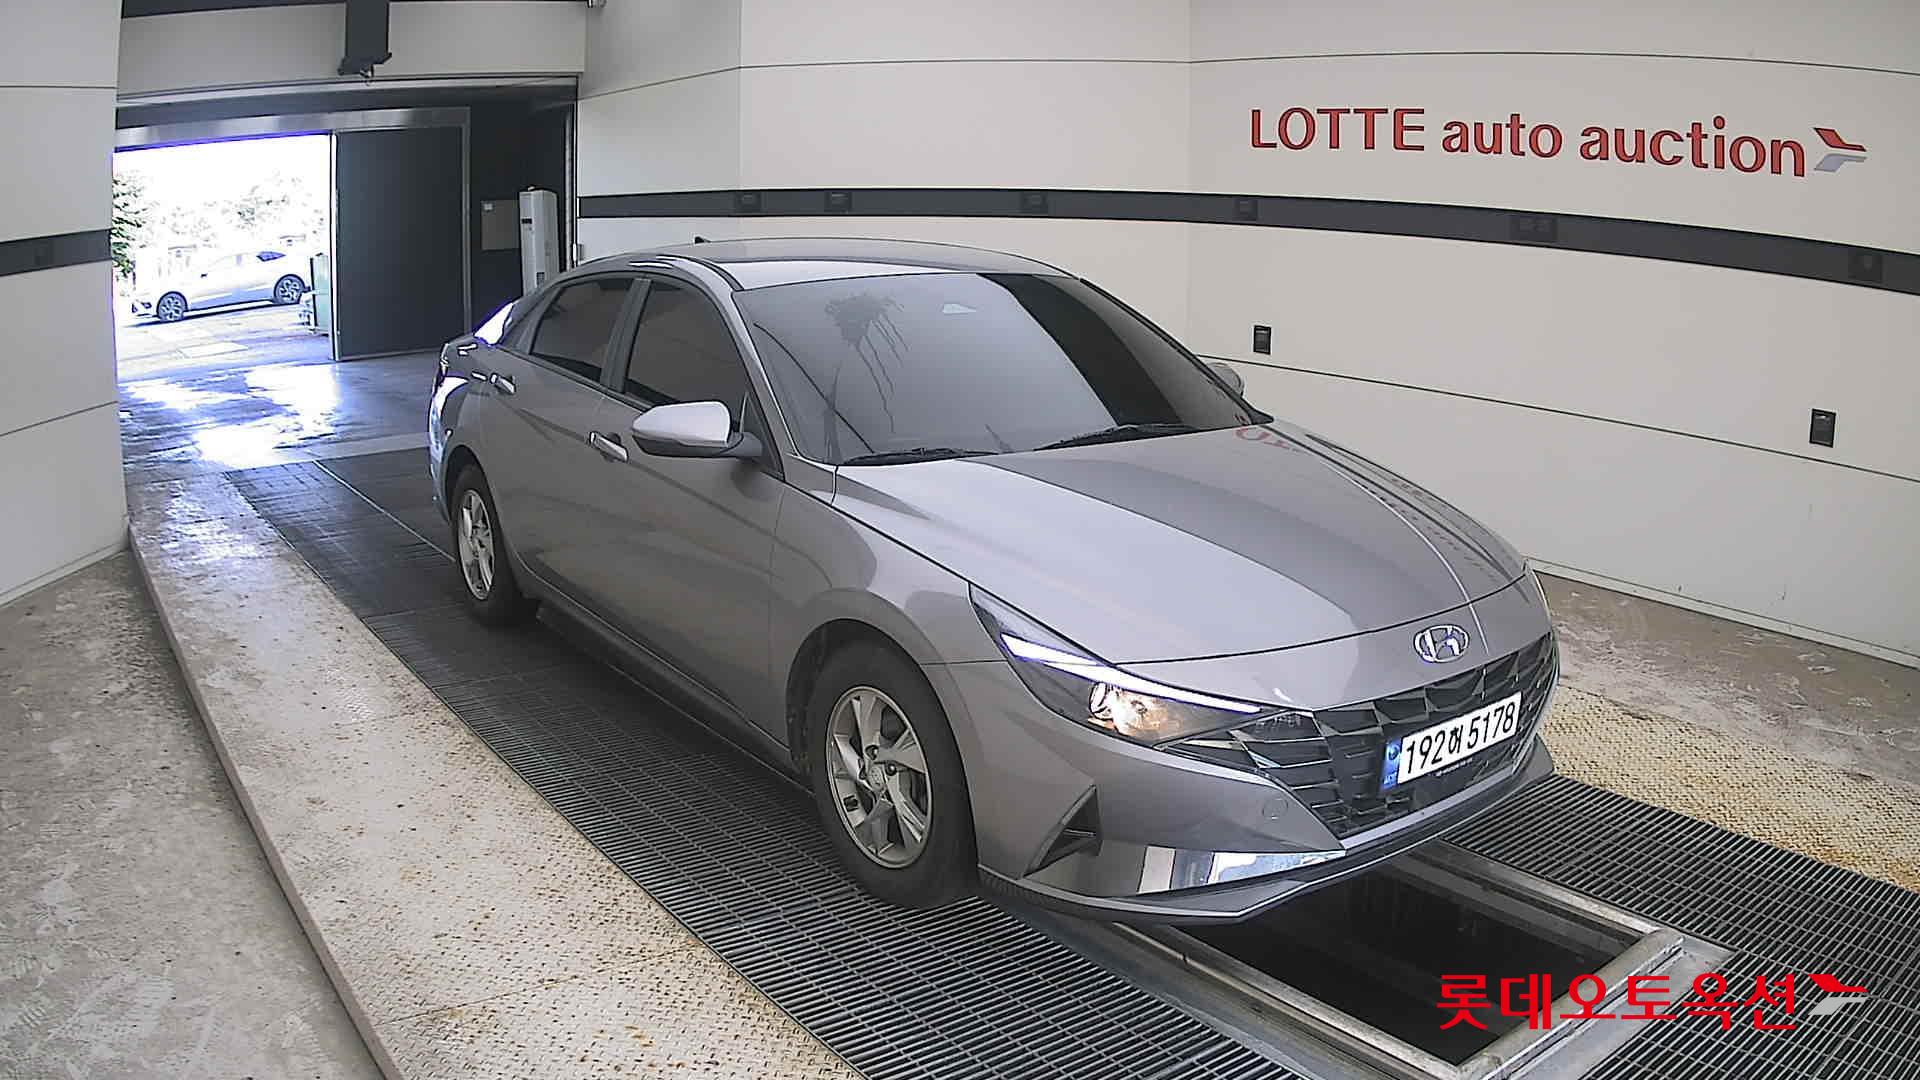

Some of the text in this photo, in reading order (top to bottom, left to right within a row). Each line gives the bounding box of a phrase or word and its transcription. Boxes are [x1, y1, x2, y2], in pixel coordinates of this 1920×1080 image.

[1250, 107, 1806, 177] LOTTE auto auction
[1467, 702, 1516, 750] 5178
